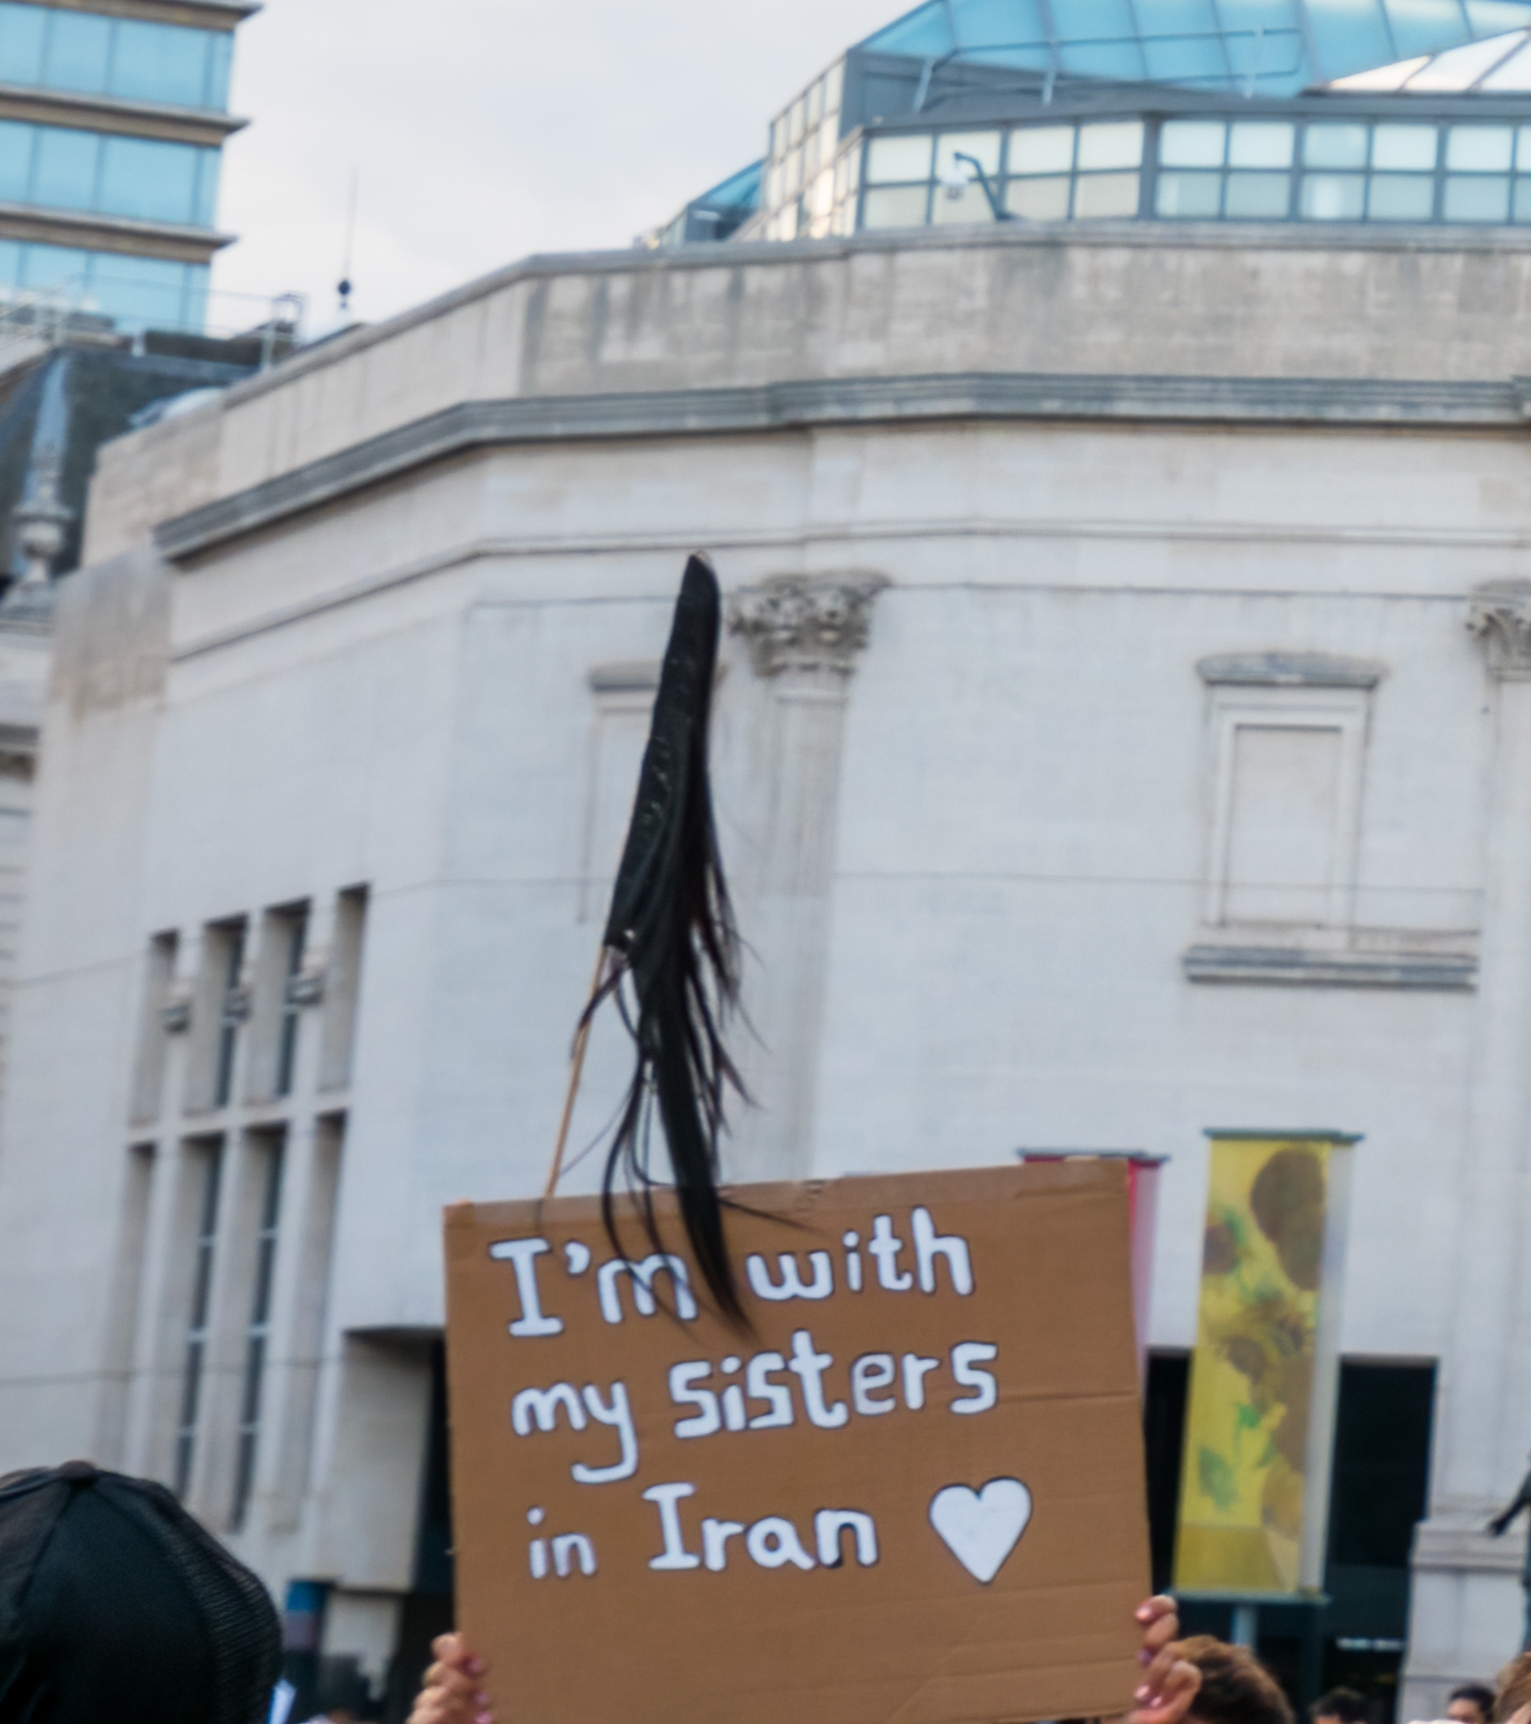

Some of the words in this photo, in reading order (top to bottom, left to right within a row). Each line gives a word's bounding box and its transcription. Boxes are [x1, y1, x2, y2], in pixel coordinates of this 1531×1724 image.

[745, 1204, 975, 1301] with
[510, 1380, 639, 1485] my
[667, 1327, 999, 1439] sisters
[525, 1505, 598, 1580] in
[640, 1481, 879, 1572] Iran
